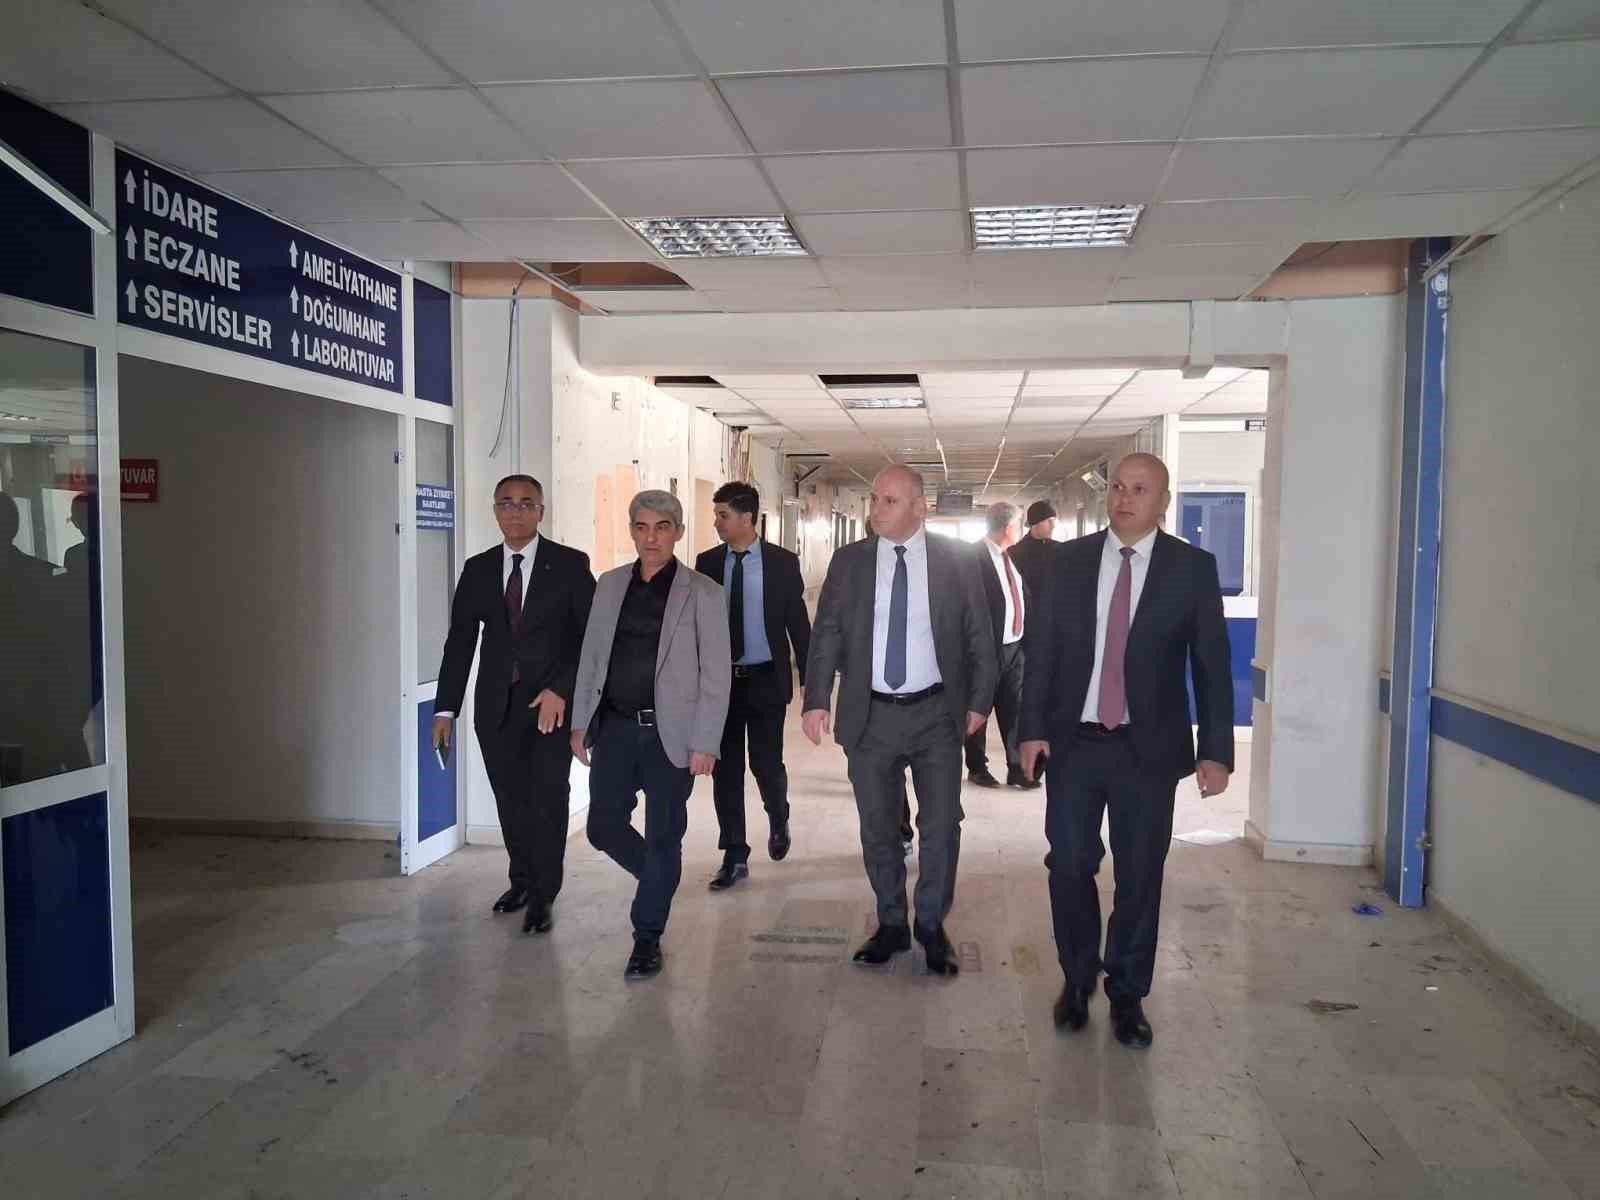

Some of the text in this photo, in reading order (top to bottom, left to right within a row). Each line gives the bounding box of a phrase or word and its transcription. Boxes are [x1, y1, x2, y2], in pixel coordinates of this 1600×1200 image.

[143, 170, 218, 238] İDARE
[143, 228, 241, 292] ECZANE
[301, 250, 397, 311] AMELİYATHANE
[144, 285, 272, 350] SERVİSLER
[303, 293, 386, 346] DOĞUMHANE
[304, 334, 395, 383] LABORATUVAR
